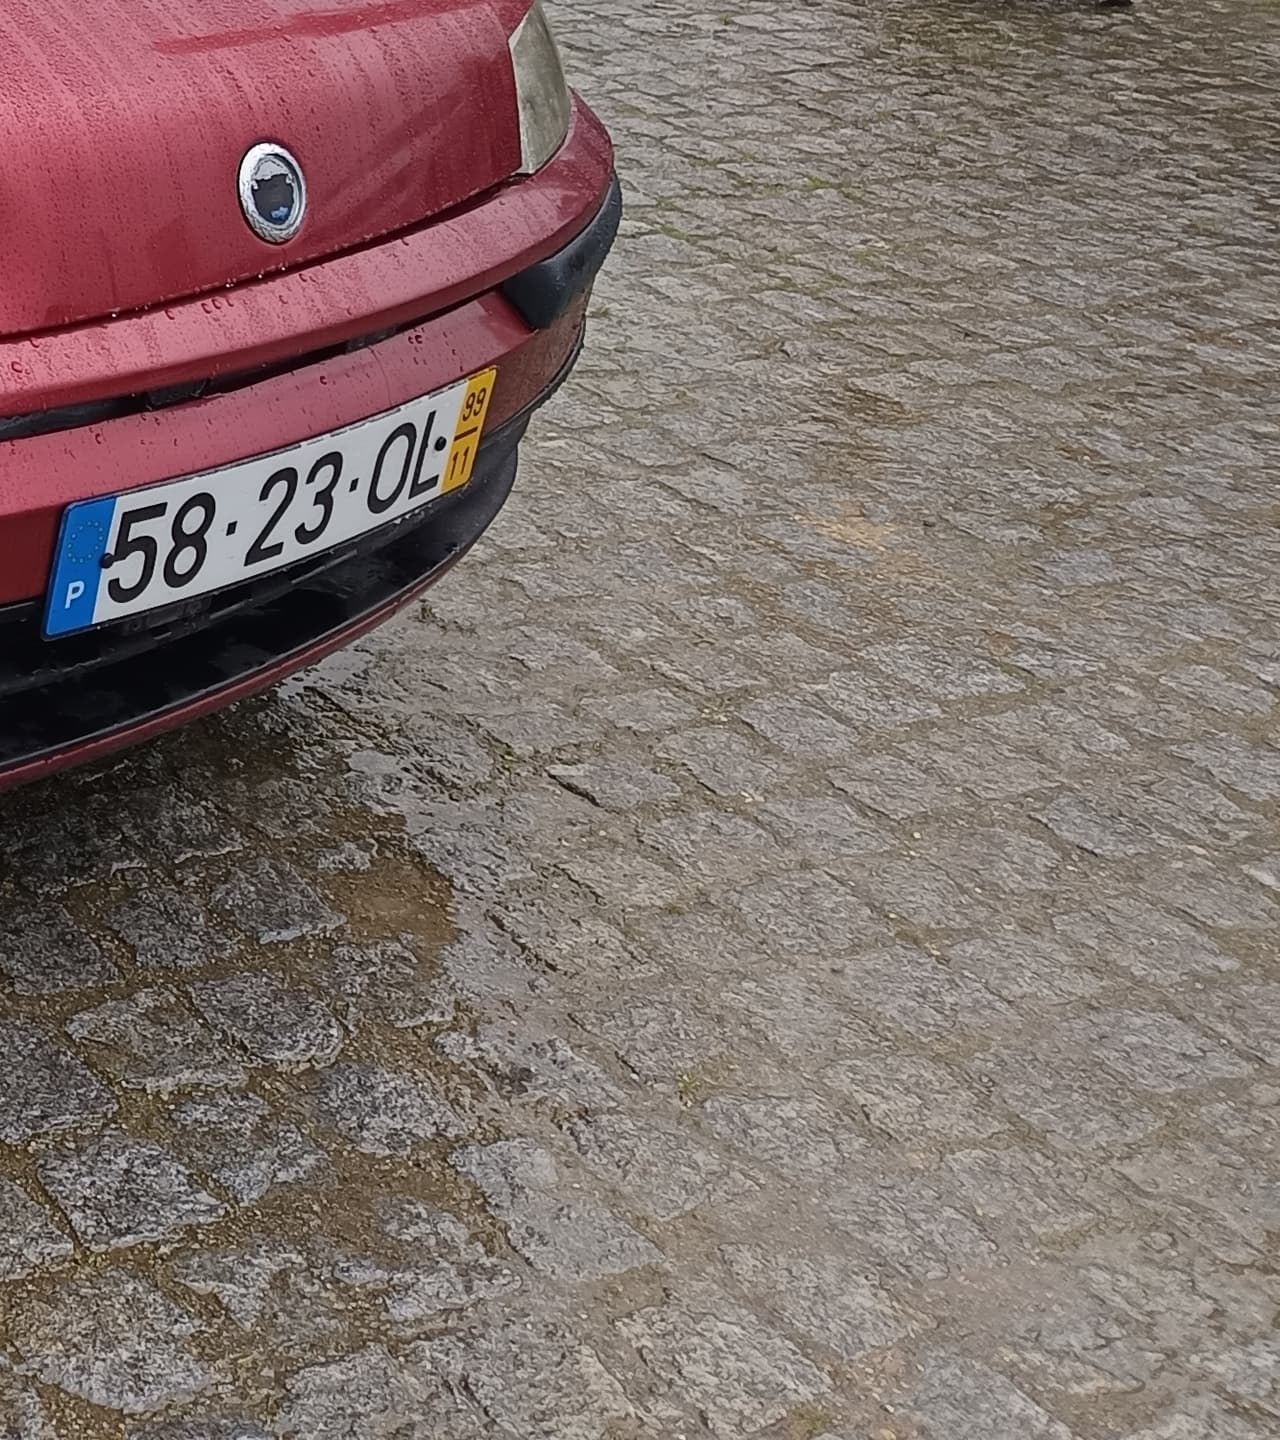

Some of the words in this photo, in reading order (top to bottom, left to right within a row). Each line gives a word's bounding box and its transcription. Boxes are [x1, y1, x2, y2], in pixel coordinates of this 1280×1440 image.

[462, 387, 487, 423] 99
[449, 450, 469, 481] 11
[65, 580, 85, 609] P
